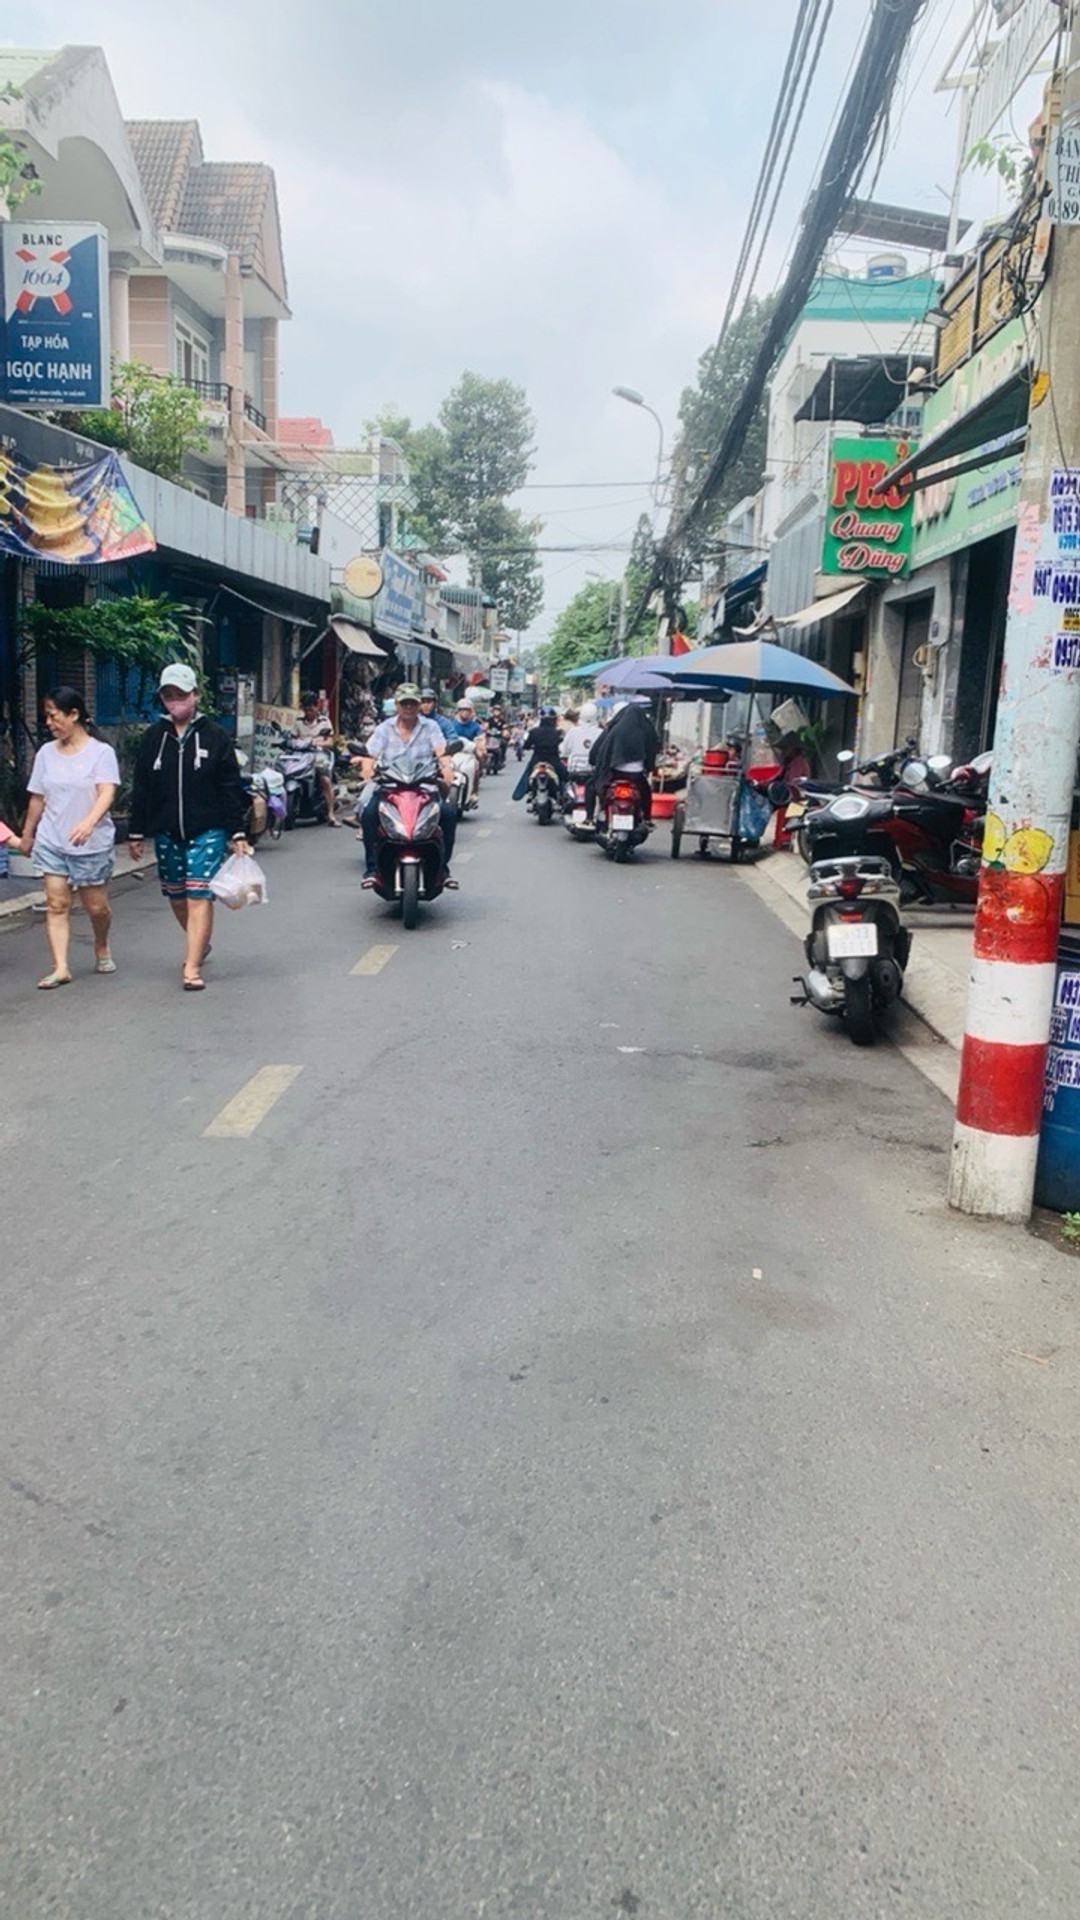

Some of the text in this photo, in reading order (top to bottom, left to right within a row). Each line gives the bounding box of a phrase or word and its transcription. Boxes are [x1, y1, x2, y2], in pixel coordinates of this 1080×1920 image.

[22, 233, 63, 246] BLANC
[21, 333, 70, 351] TẠP HÓA
[47, 362, 92, 384] HẠNH
[830, 511, 903, 542] Quang
[1052, 574, 1080, 604] 0968
[1055, 638, 1080, 668] 0937
